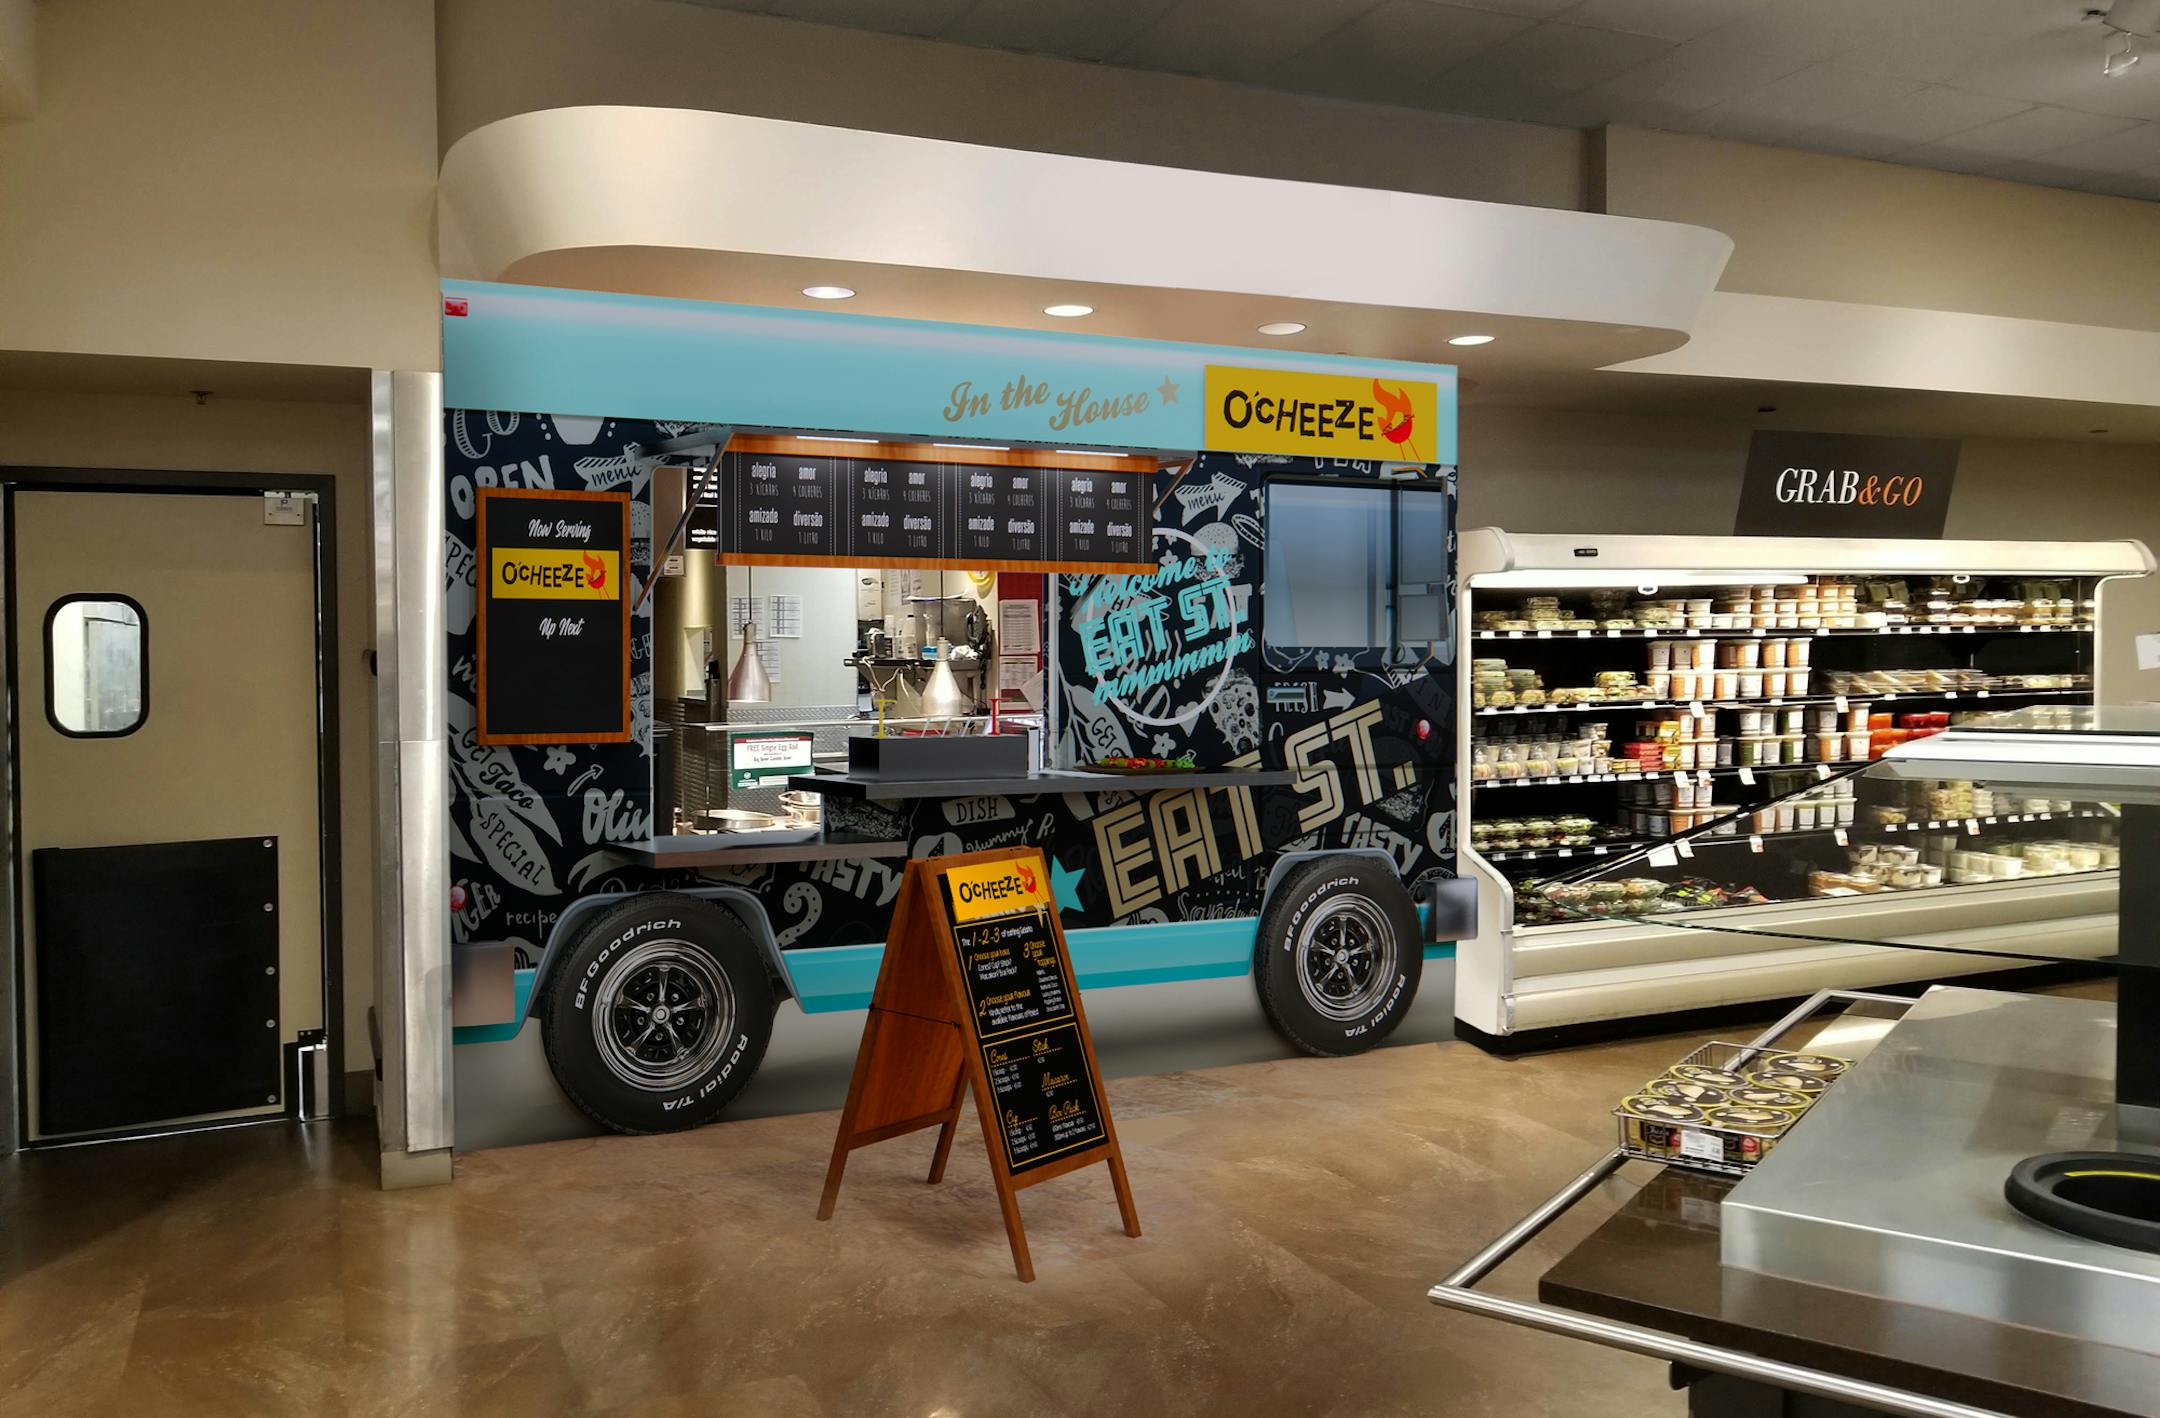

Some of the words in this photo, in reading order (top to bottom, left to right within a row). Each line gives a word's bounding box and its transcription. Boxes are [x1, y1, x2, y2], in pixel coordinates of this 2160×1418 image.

[943, 381, 991, 423] In
[1000, 374, 1050, 411] the
[1048, 386, 1150, 432] House
[1223, 389, 1375, 441] O'CHEEZE
[592, 466, 642, 487] menu
[751, 462, 777, 480] alegria
[799, 466, 817, 480] amor
[864, 468, 888, 486] alegria
[908, 471, 926, 485] amor
[1012, 476, 1029, 490] amor
[1188, 492, 1226, 511] menu
[749, 507, 779, 525] amizade
[793, 511, 823, 528] diversão
[861, 512, 890, 528] amizade
[528, 519, 552, 538] Now
[555, 520, 592, 543] Serving
[1205, 544, 1233, 571] to
[502, 561, 584, 588] O'CHEEZE
[539, 617, 556, 640] Up
[559, 618, 586, 636] Next
[1078, 596, 1169, 676] EAT
[479, 762, 534, 809] Taco
[956, 797, 999, 823] DISH
[1092, 750, 1263, 919] EAT
[1284, 698, 1416, 833] ST.
[480, 812, 545, 887] SPECIAL
[1341, 812, 1423, 875] TASTY
[959, 876, 1023, 903] O'CHEEZE
[1284, 876, 1360, 952] BFGoodrich
[575, 919, 682, 1010] BFGoodrich
[1371, 973, 1406, 1028] Radial
[1344, 1027, 1368, 1037] T/A
[700, 1033, 748, 1099] Radial
[662, 1095, 694, 1111] T/A
